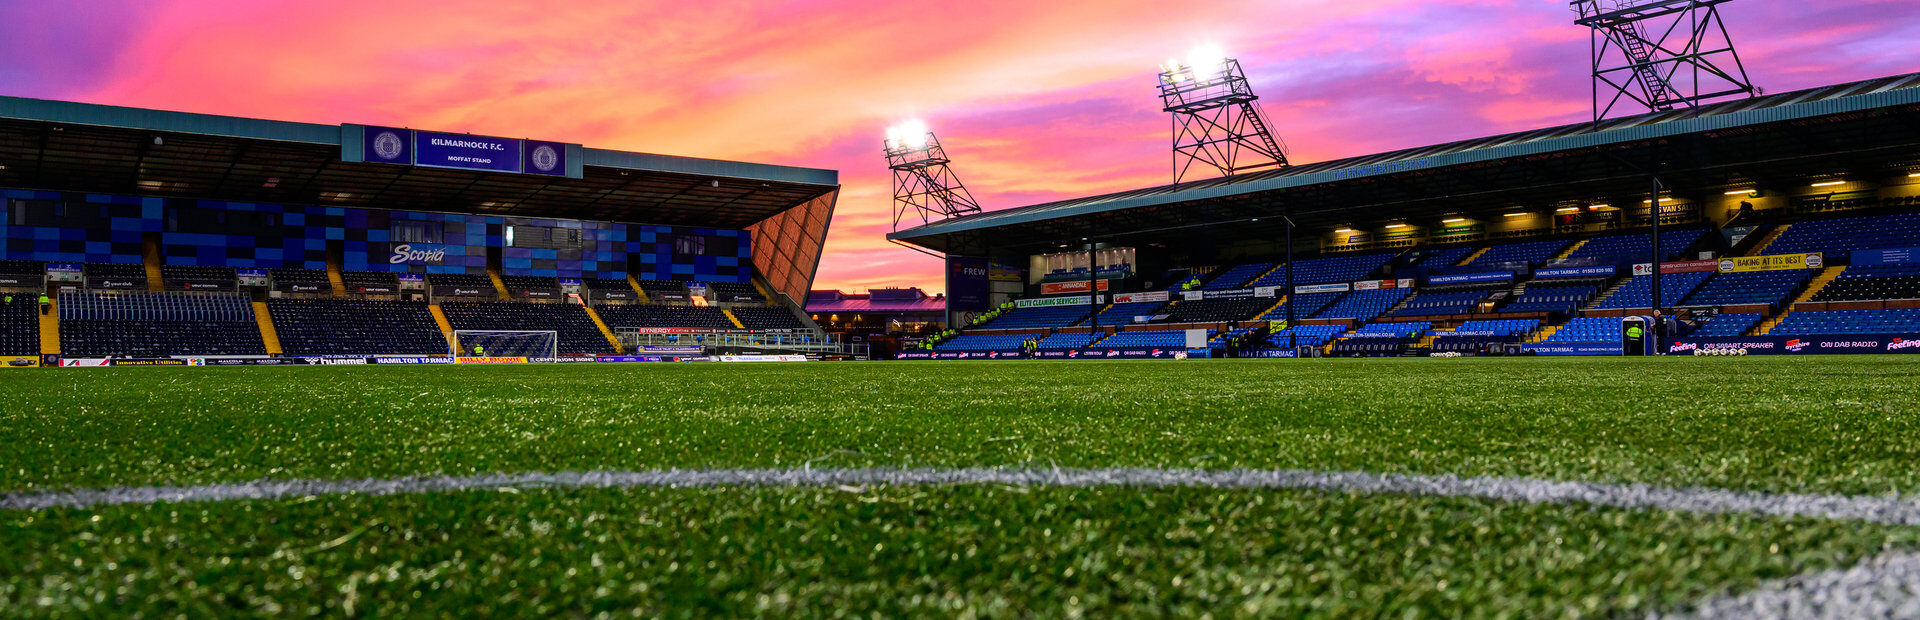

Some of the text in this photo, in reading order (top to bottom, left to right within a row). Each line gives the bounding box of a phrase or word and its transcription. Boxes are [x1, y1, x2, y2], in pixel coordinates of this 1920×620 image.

[431, 137, 505, 151] KILMARNOCK F.C.
[1662, 205, 1677, 213] VAN
[389, 244, 447, 264] Scotia
[1737, 258, 1760, 267] BAKING
[1762, 258, 1772, 266] AT
[1772, 257, 1783, 265] ITS
[1784, 255, 1801, 264] BEST
[963, 267, 986, 276] FREW
[1062, 281, 1087, 289] ANNANDALE
[1019, 300, 1032, 308] ELITE
[1032, 298, 1056, 307] CLEANING
[1670, 342, 1697, 352] Feeling
[320, 357, 367, 365] hummel
